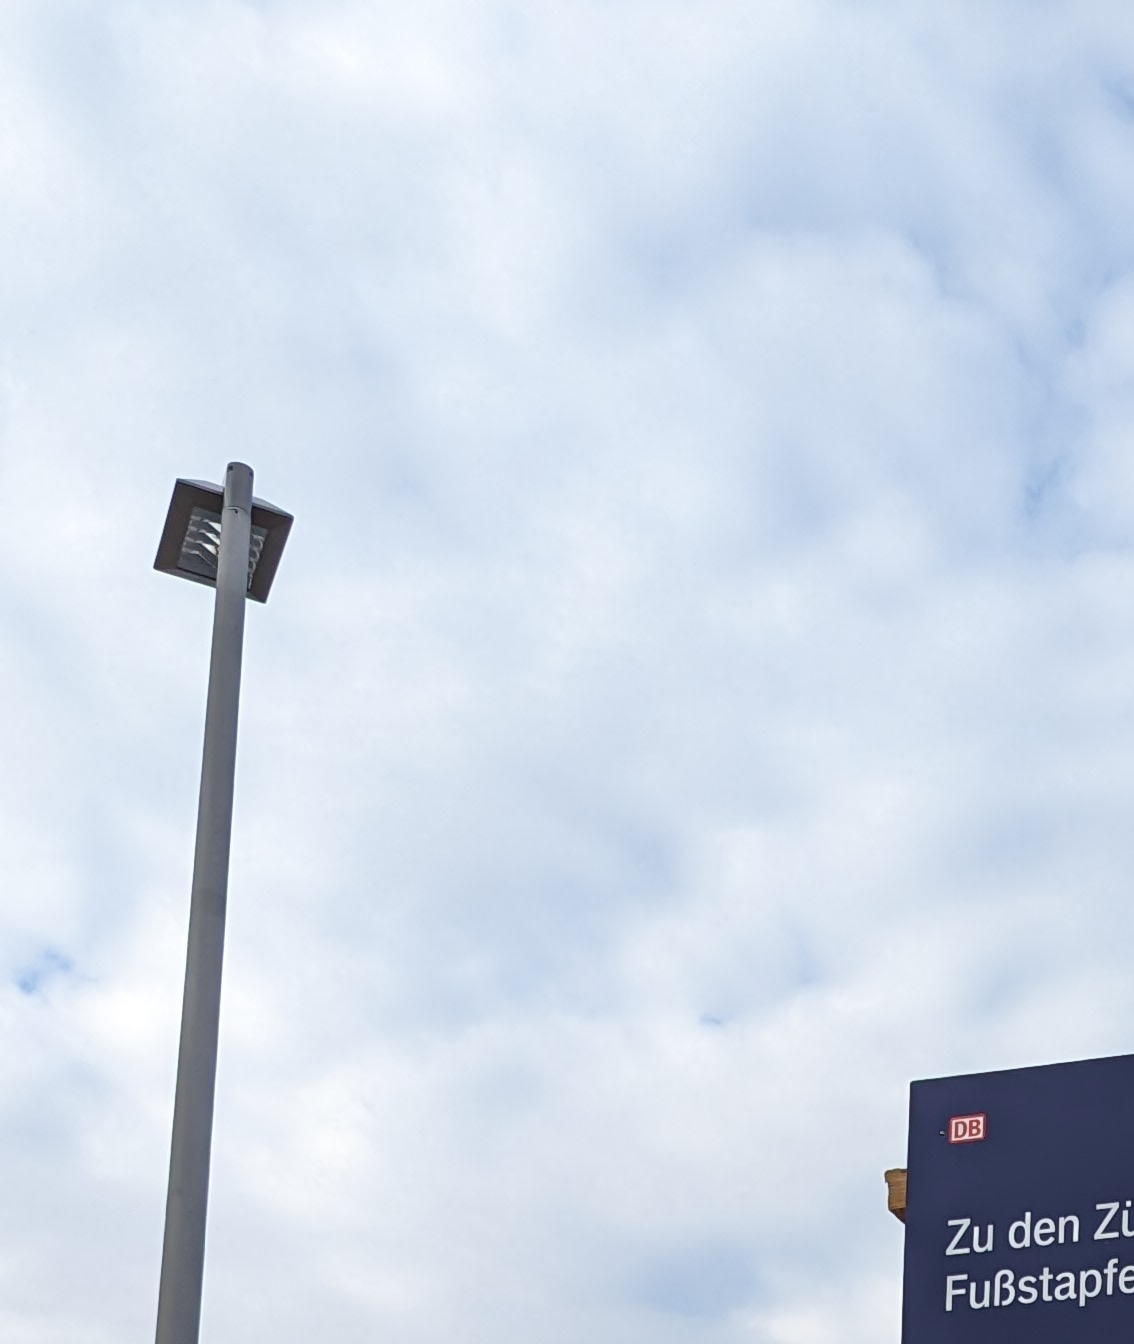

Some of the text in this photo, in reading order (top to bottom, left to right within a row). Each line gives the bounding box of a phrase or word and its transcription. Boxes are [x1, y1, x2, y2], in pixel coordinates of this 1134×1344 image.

[951, 1116, 985, 1141] DB
[945, 1218, 995, 1256] Zu
[1008, 1211, 1080, 1250] den
